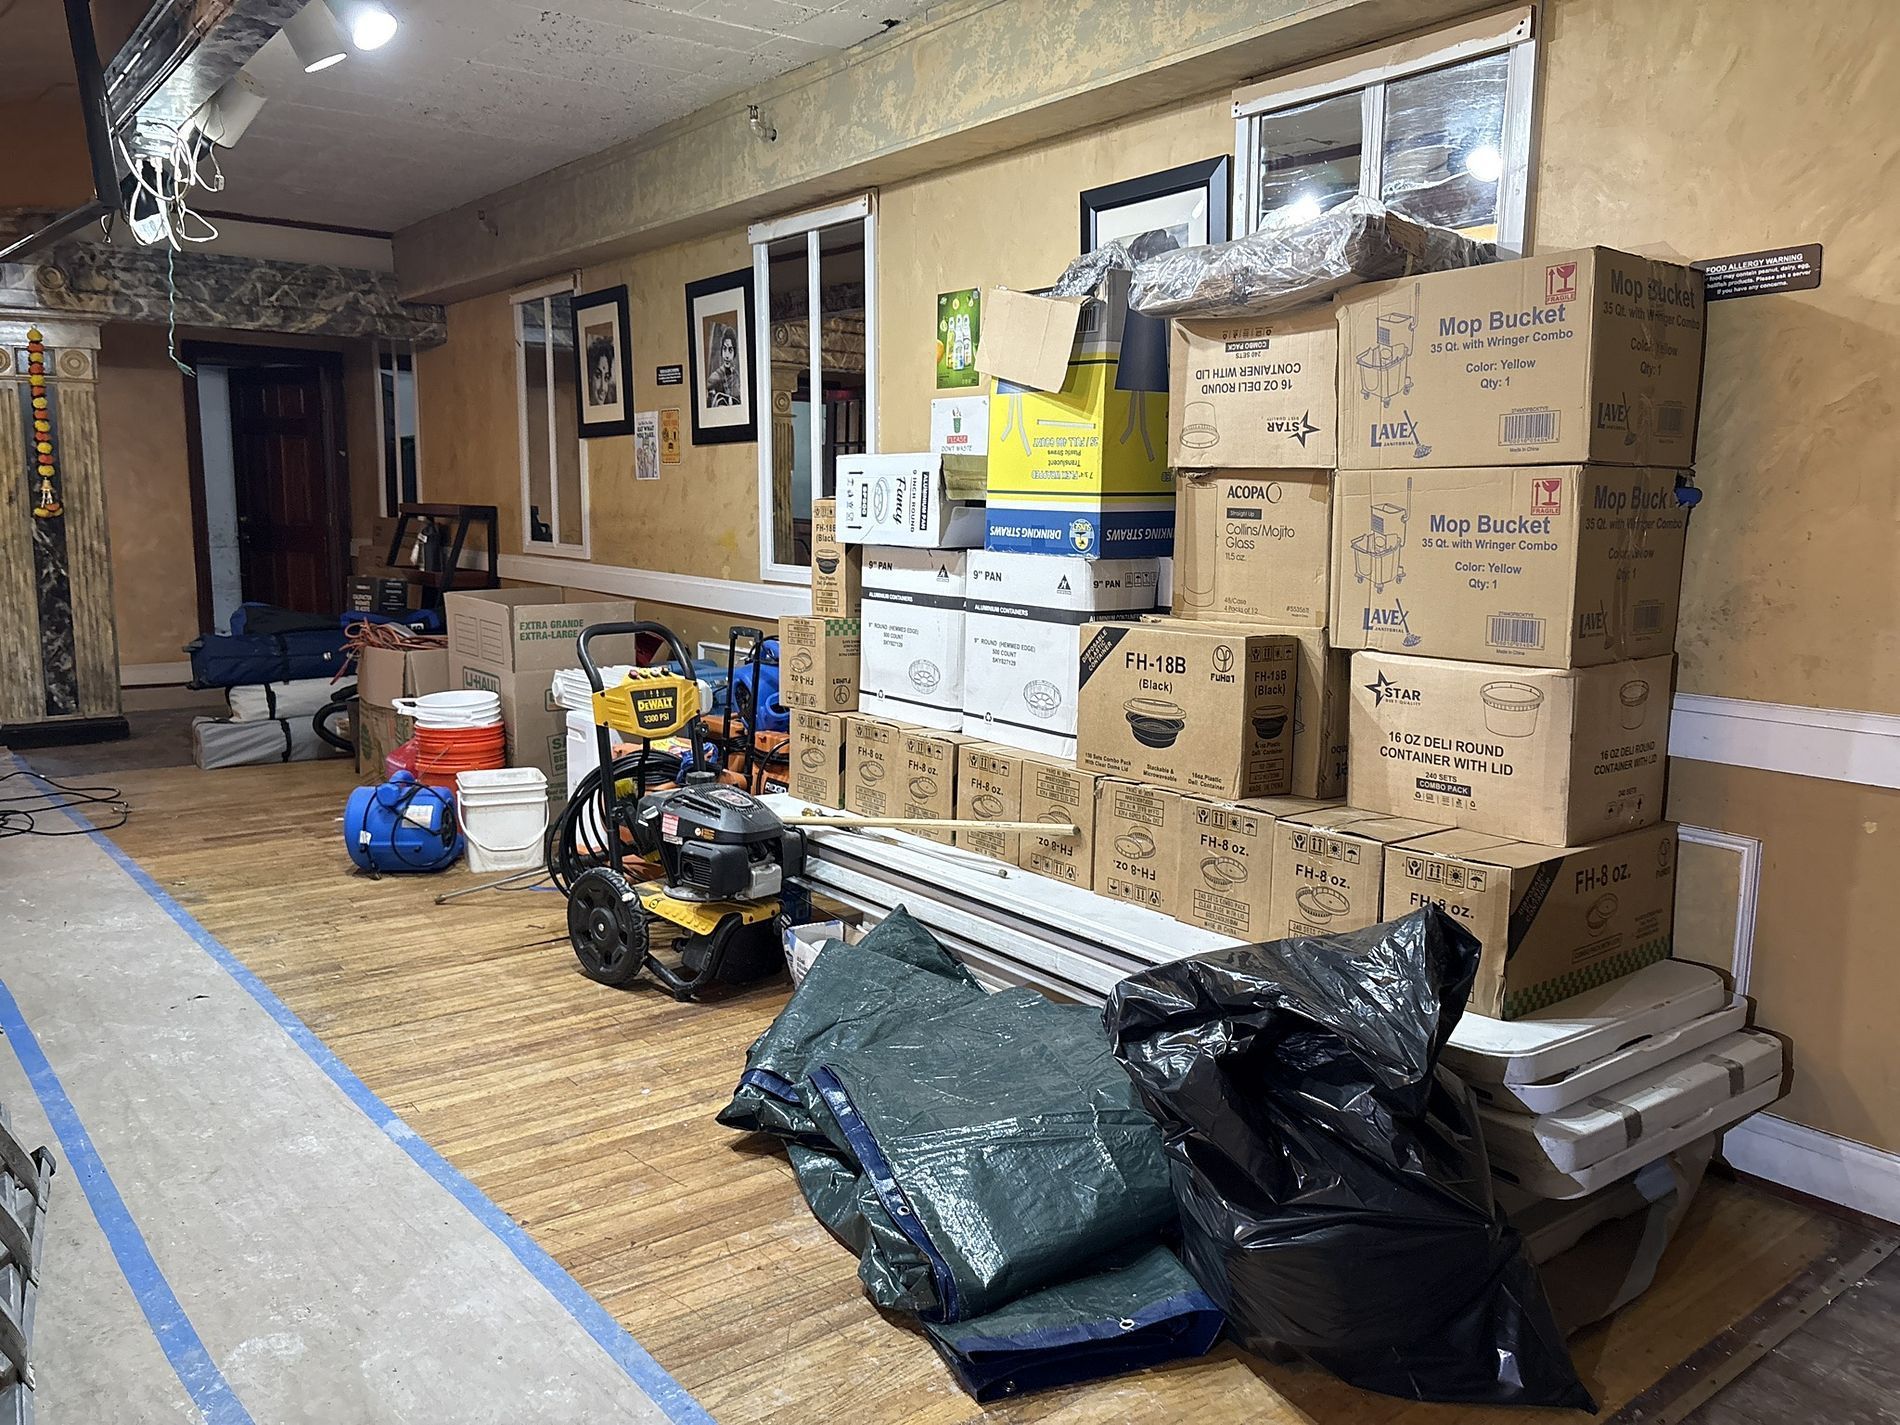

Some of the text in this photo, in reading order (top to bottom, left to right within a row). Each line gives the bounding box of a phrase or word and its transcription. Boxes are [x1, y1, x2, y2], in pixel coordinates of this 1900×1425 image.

[1705, 253, 1803, 275] FOOD ALLERGY WARNING
[1723, 273, 1735, 281] may
[1756, 275, 1775, 283] Please
[1611, 269, 1642, 303] Mop
[1547, 293, 1575, 304] FRAGILE
[1439, 303, 1566, 337] Mop Bucket
[1227, 341, 1267, 351] COMBO PACK
[1430, 328, 1573, 353] 35 Qt. with Wringer Combo
[1195, 362, 1301, 380] CONTAINER WITH LID
[1466, 358, 1536, 374] Color: Yellow
[1201, 379, 1292, 395] 16 OZ DELI ROUND
[1480, 378, 1502, 390] Qty:
[1597, 402, 1630, 429] LAVEX
[1266, 421, 1300, 432] STAR
[1371, 420, 1418, 447] LAVEX
[1227, 485, 1265, 500] ACOPA
[892, 476, 907, 525] Fancy
[1594, 485, 1626, 515] Mop
[1532, 507, 1560, 515] FRAGILE
[990, 525, 1020, 536] STRAWS
[1430, 514, 1550, 537] Mop Bucket
[1585, 518, 1595, 529] 35
[1656, 518, 1682, 529] Combo
[1021, 526, 1061, 539] DRINKING
[1106, 529, 1142, 541] STRAWS
[1225, 523, 1295, 540] Collins/Mojito
[1225, 537, 1255, 550] Glass
[1422, 538, 1558, 552] 35 Qt. with Wringer Combo
[878, 561, 893, 571] PAN
[1455, 561, 1522, 575] Color: Yellow
[984, 570, 1002, 582] PAN
[1105, 579, 1121, 589] PAN
[1468, 578, 1490, 590] Qty:
[520, 619, 584, 630] EXTRA GRANDE
[1362, 607, 1409, 631] LAVEX
[1579, 611, 1607, 638] LAVEX
[520, 630, 578, 641] EXTRA-LARGE
[981, 638, 998, 647] ROUND
[1081, 629, 1109, 664] DISPOSABLE
[1088, 640, 1107, 662] PLASTIC
[1000, 650, 1017, 658] COUNT
[1088, 641, 1113, 671] CONTAINER
[1125, 652, 1187, 674] FH-18B
[1254, 670, 1287, 682] FH-18B
[1138, 678, 1173, 695] (Black)
[1254, 684, 1286, 698] (Black)
[1385, 687, 1421, 702] STAR
[644, 713, 669, 723] 3300 PSI
[800, 733, 826, 747] FH-8 oz.
[1388, 731, 1504, 758] 16 OZ DELI ROUND
[858, 747, 884, 761] FH-8 oz.
[1103, 755, 1131, 766] Combo Pack
[1600, 750, 1609, 760] 16
[1609, 748, 1619, 759] OZ
[908, 759, 939, 776] FH-8 oz.
[1379, 746, 1514, 777] CONTAINER WITH LID
[1594, 760, 1633, 775] CONTAINER
[1143, 770, 1177, 782] Microwaveable
[1147, 764, 1169, 774] Stackable
[1425, 771, 1457, 783] 240 SETS
[971, 778, 1004, 796] FH-8 oz.
[1200, 781, 1225, 791] Container
[1419, 781, 1469, 795] COMBO PACK
[1036, 836, 1073, 856] FH-8 oz.
[1200, 833, 1249, 856] FH-8 oz.
[1113, 859, 1156, 881] FH-8 oz.
[1295, 864, 1351, 890] FH-8 oz.
[1575, 864, 1608, 894] FH-8
[1613, 863, 1631, 883] oz.
[1410, 892, 1474, 919] FH8 oz.
